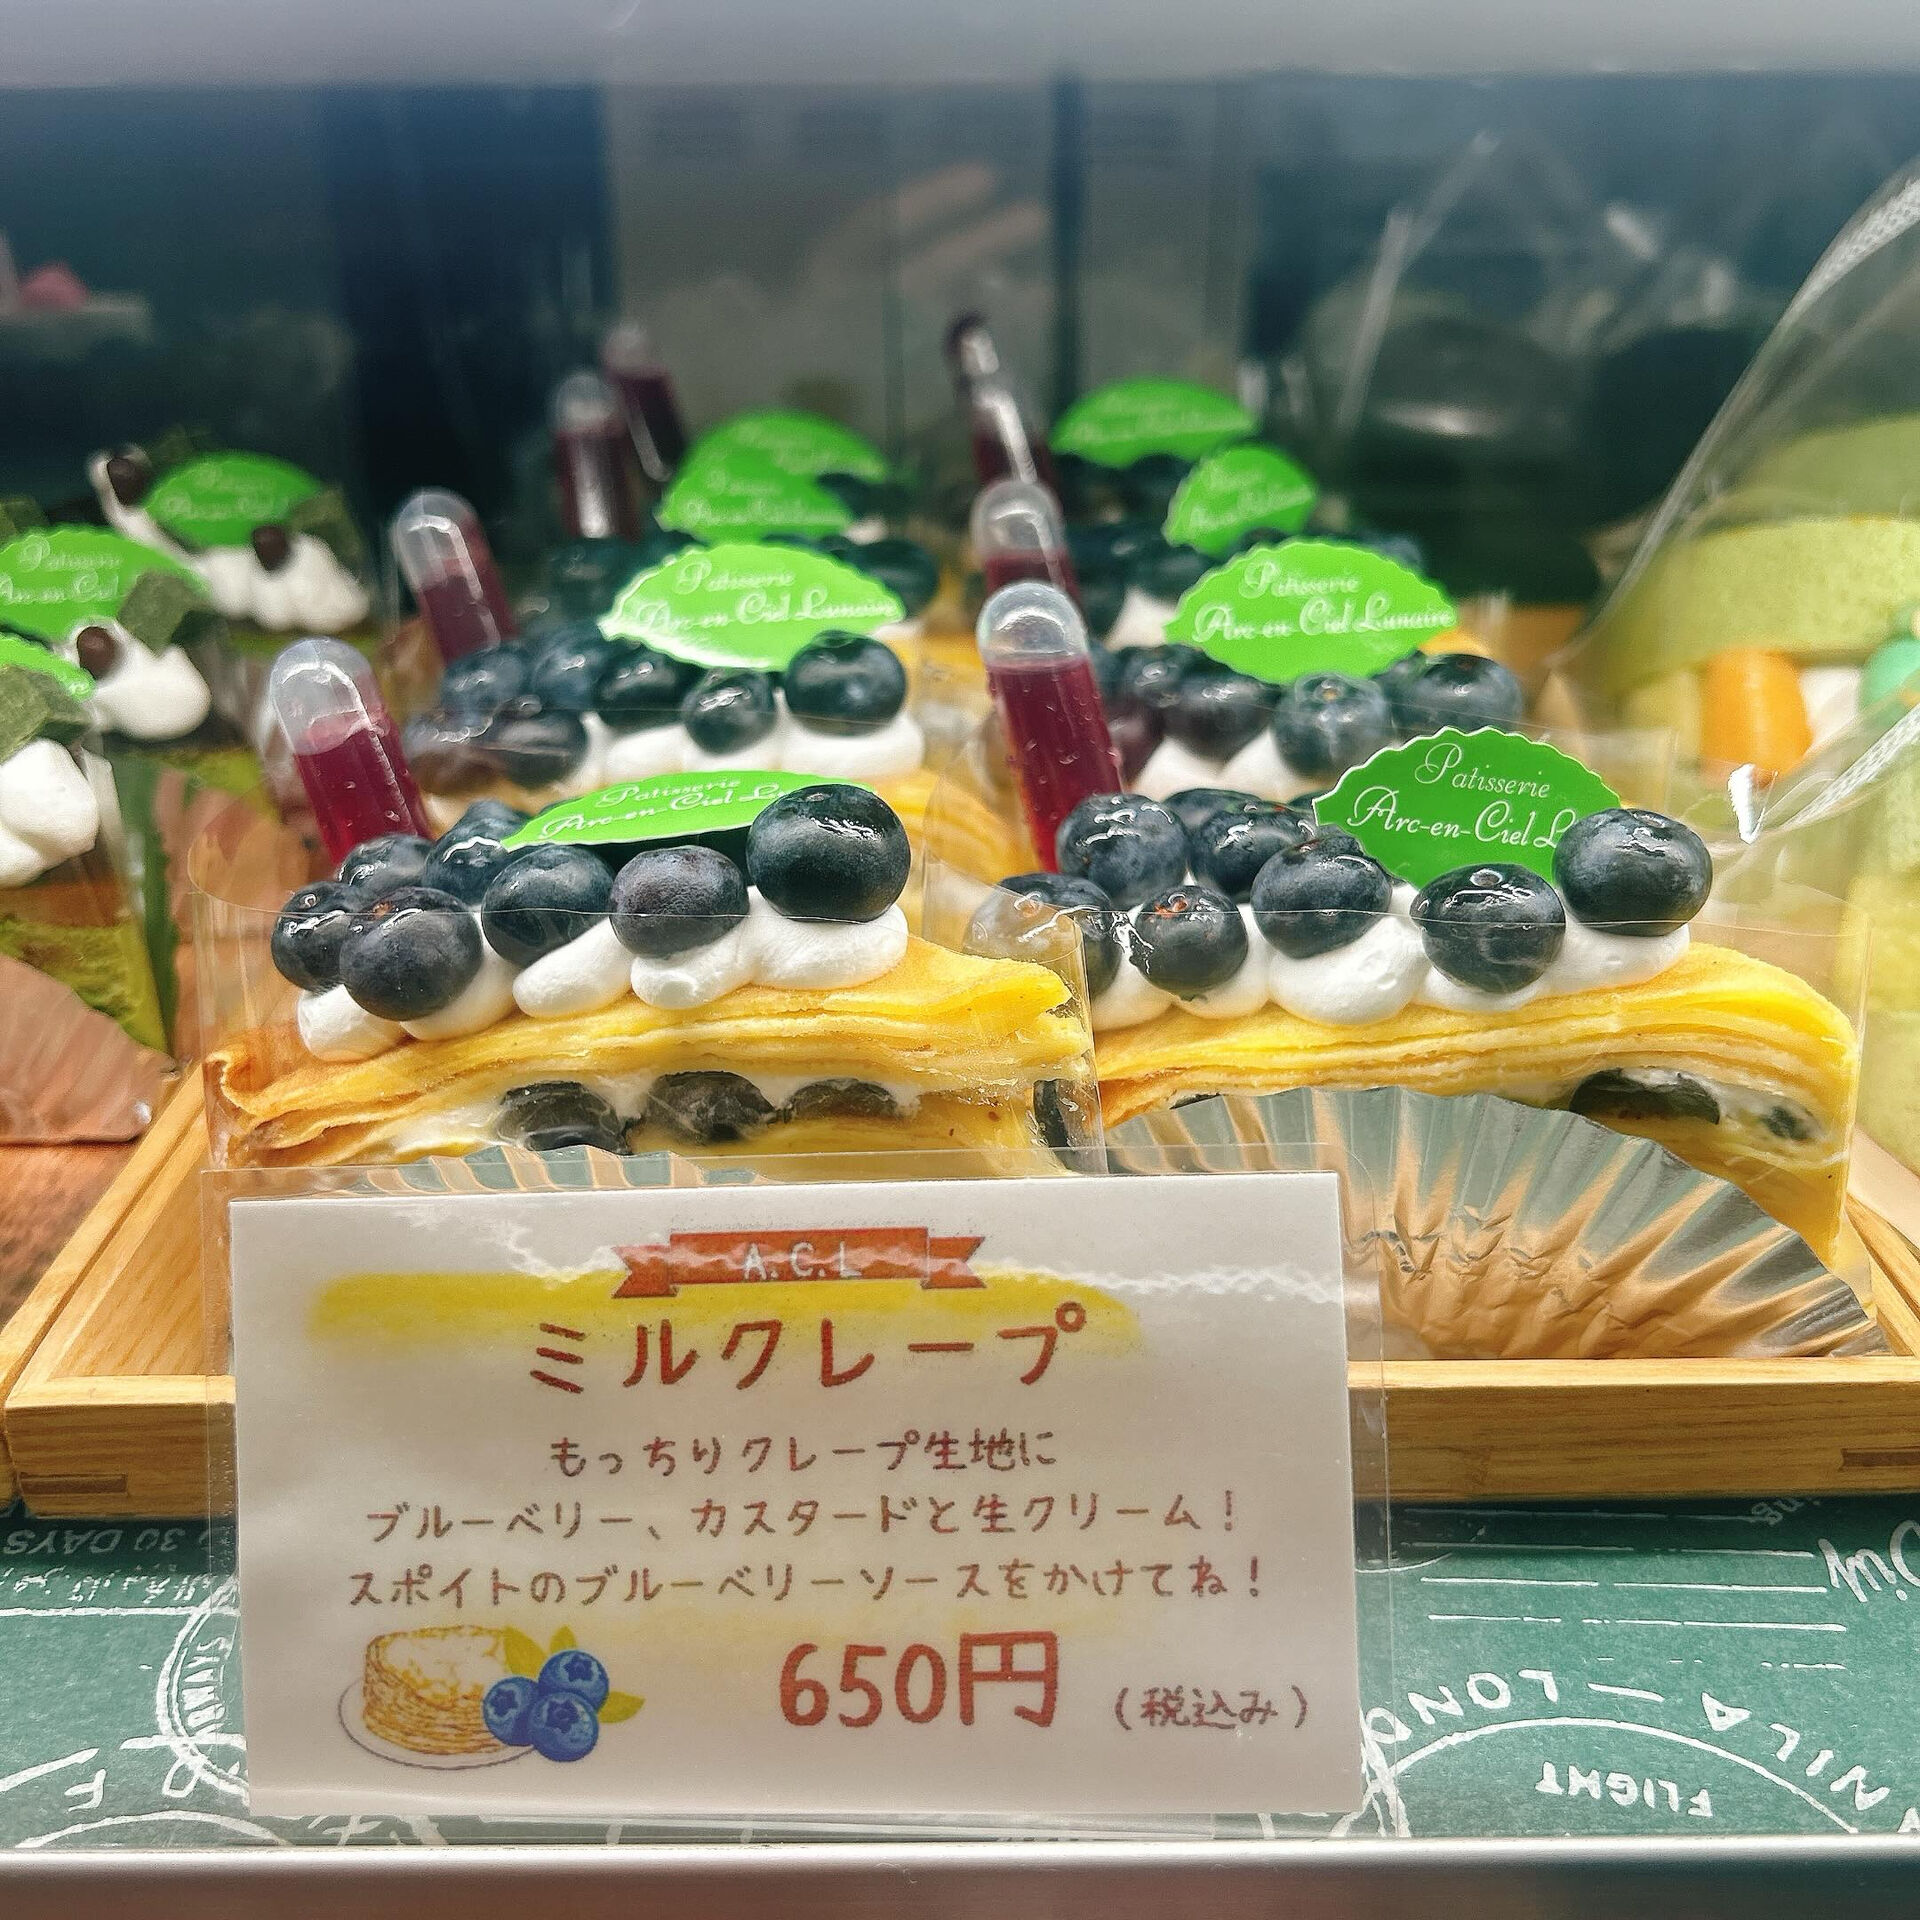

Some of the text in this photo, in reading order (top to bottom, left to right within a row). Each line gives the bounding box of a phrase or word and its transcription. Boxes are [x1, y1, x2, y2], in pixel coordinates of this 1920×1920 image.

[595, 776, 741, 808] Patisserie
[1414, 742, 1551, 799] Patisserie
[1347, 785, 1536, 848] Arc-en-Ciel
[530, 1302, 1086, 1394] ミルクレープ
[550, 1427, 1057, 1478] もっちりクレープ生地に
[779, 1630, 1060, 1729] 650円
[1535, 1760, 1713, 1819] FLIGHT
